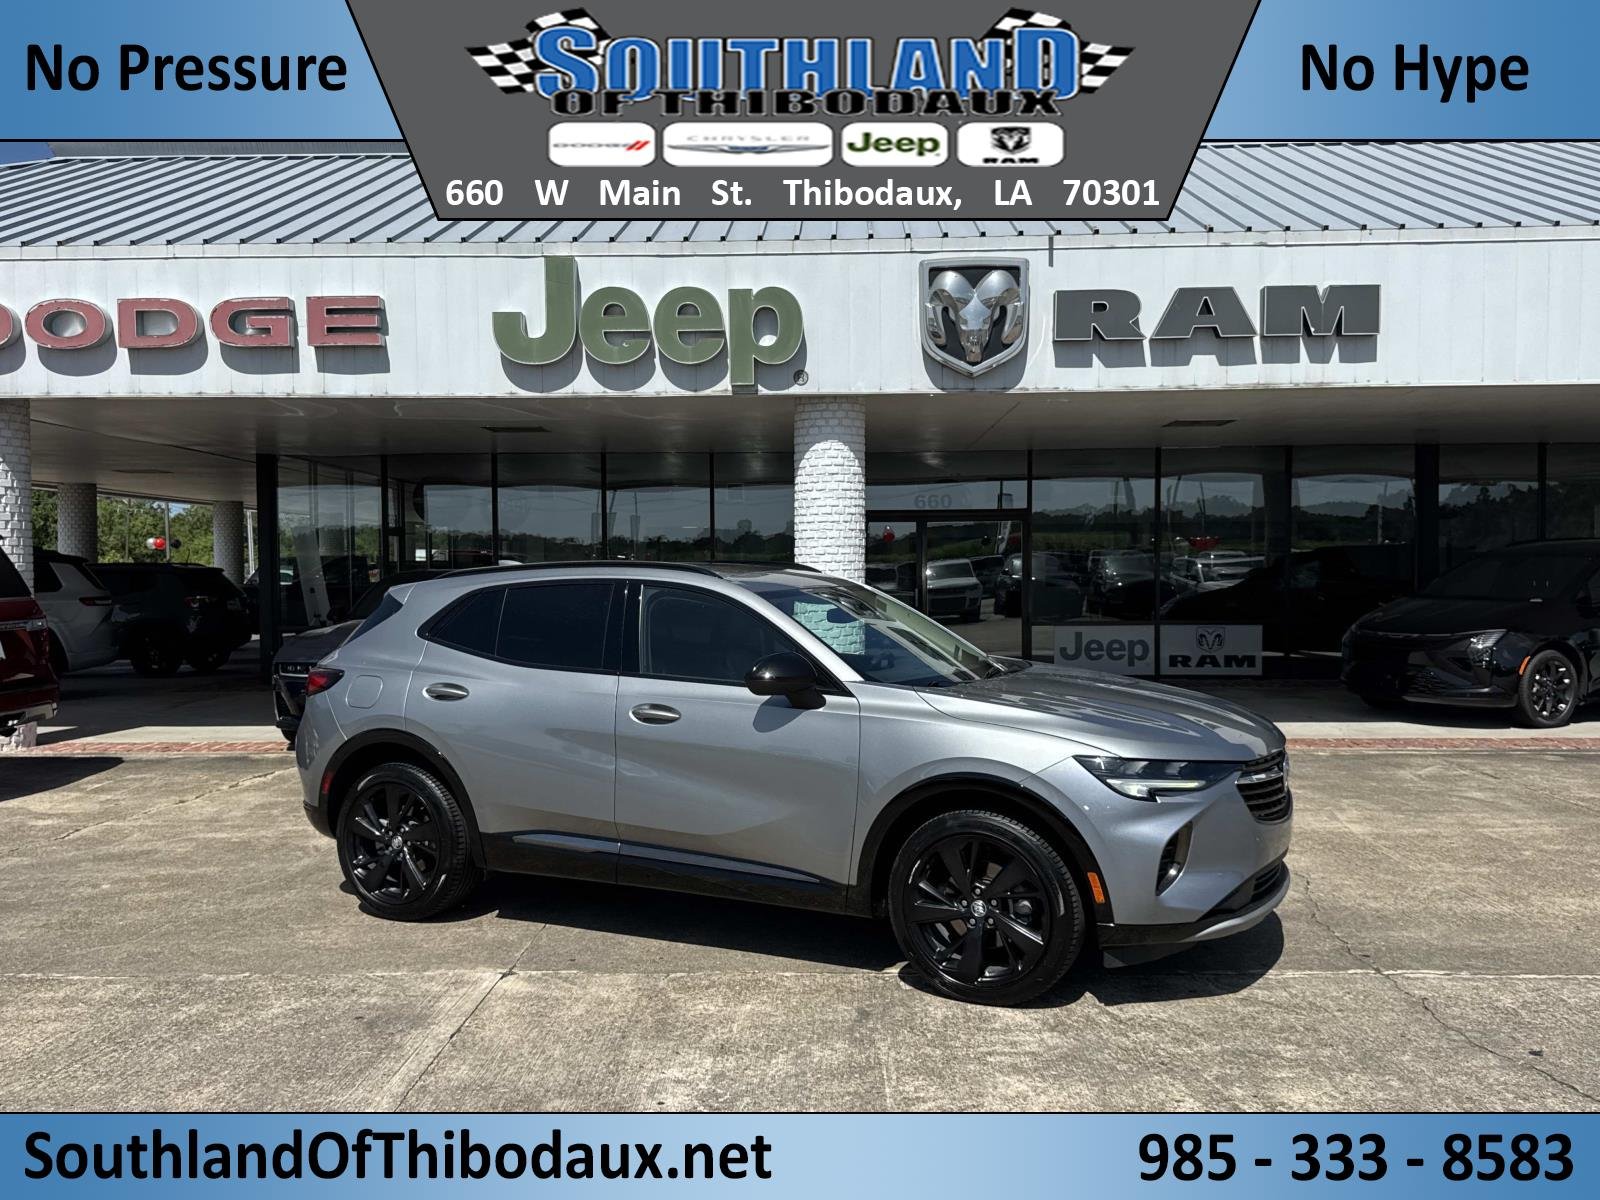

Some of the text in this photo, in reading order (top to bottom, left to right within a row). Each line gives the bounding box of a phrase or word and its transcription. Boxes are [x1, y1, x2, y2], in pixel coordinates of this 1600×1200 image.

[493, 256, 804, 388] Jeep
[1054, 284, 1381, 342] RAM
[914, 494, 953, 509] 660
[1059, 631, 1150, 667] Jeep
[1168, 655, 1257, 669] RAM
